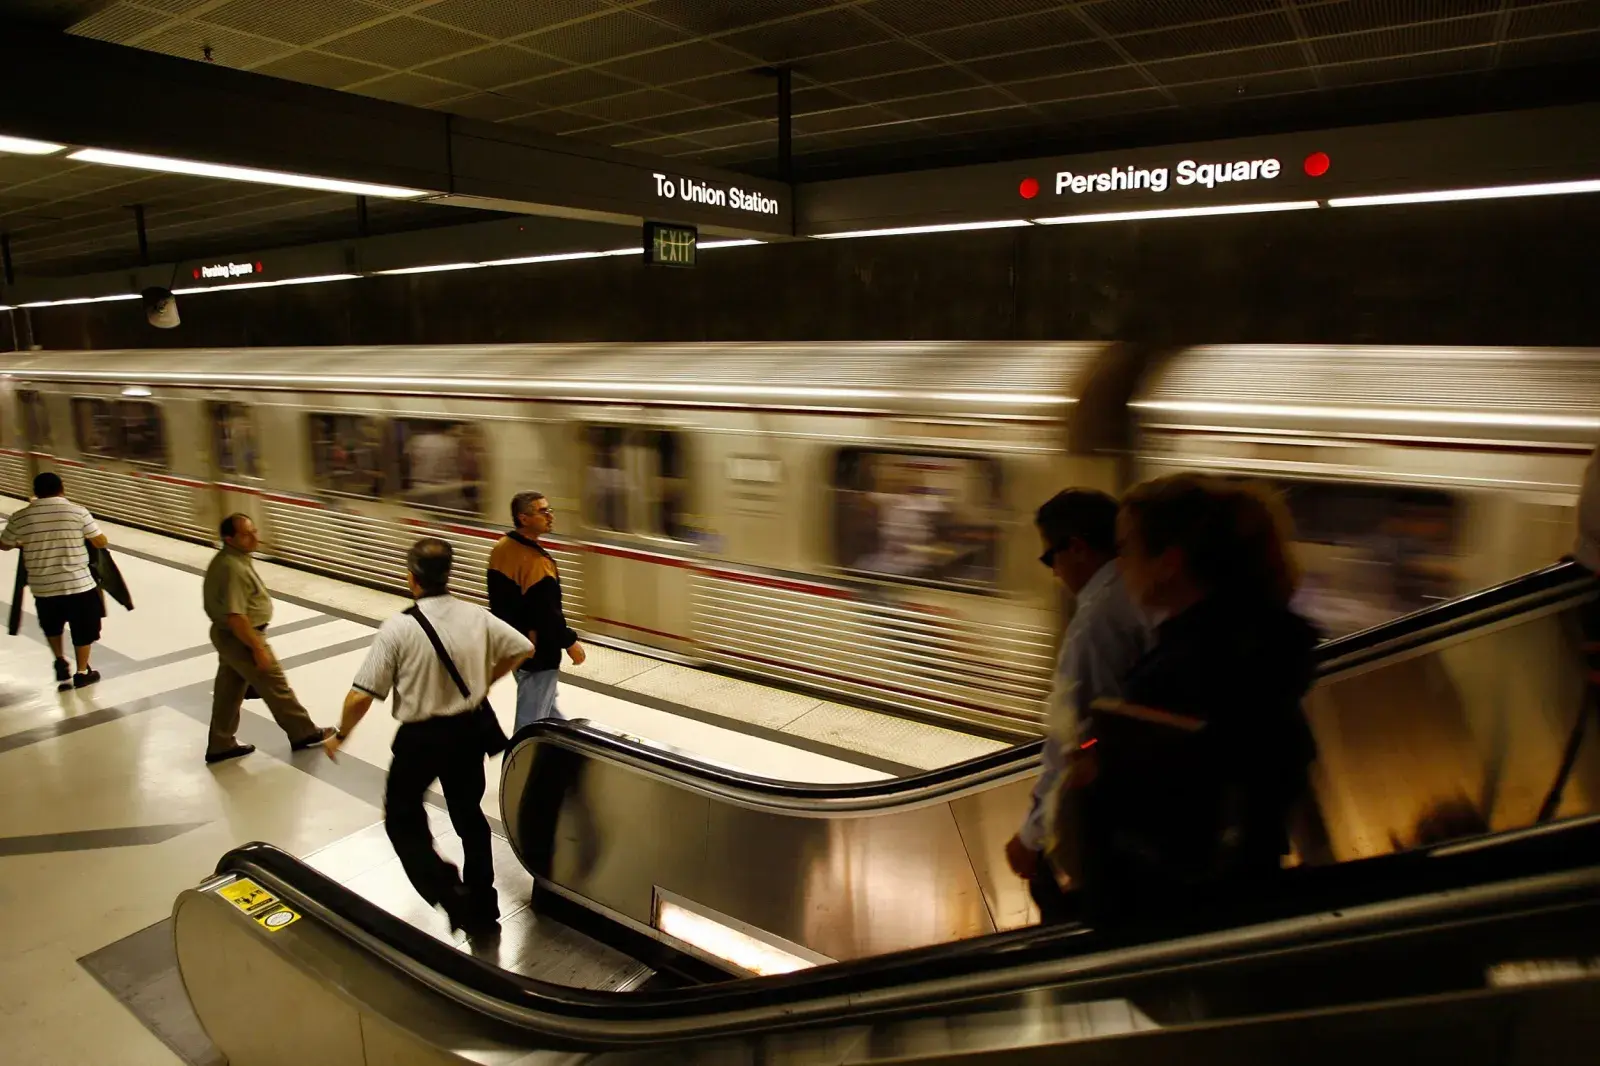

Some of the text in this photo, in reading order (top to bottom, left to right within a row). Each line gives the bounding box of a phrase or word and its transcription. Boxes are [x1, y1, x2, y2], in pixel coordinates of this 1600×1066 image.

[652, 172, 779, 215] To Union Station
[1055, 158, 1281, 195] Pershing Square
[659, 229, 691, 263] EXIT
